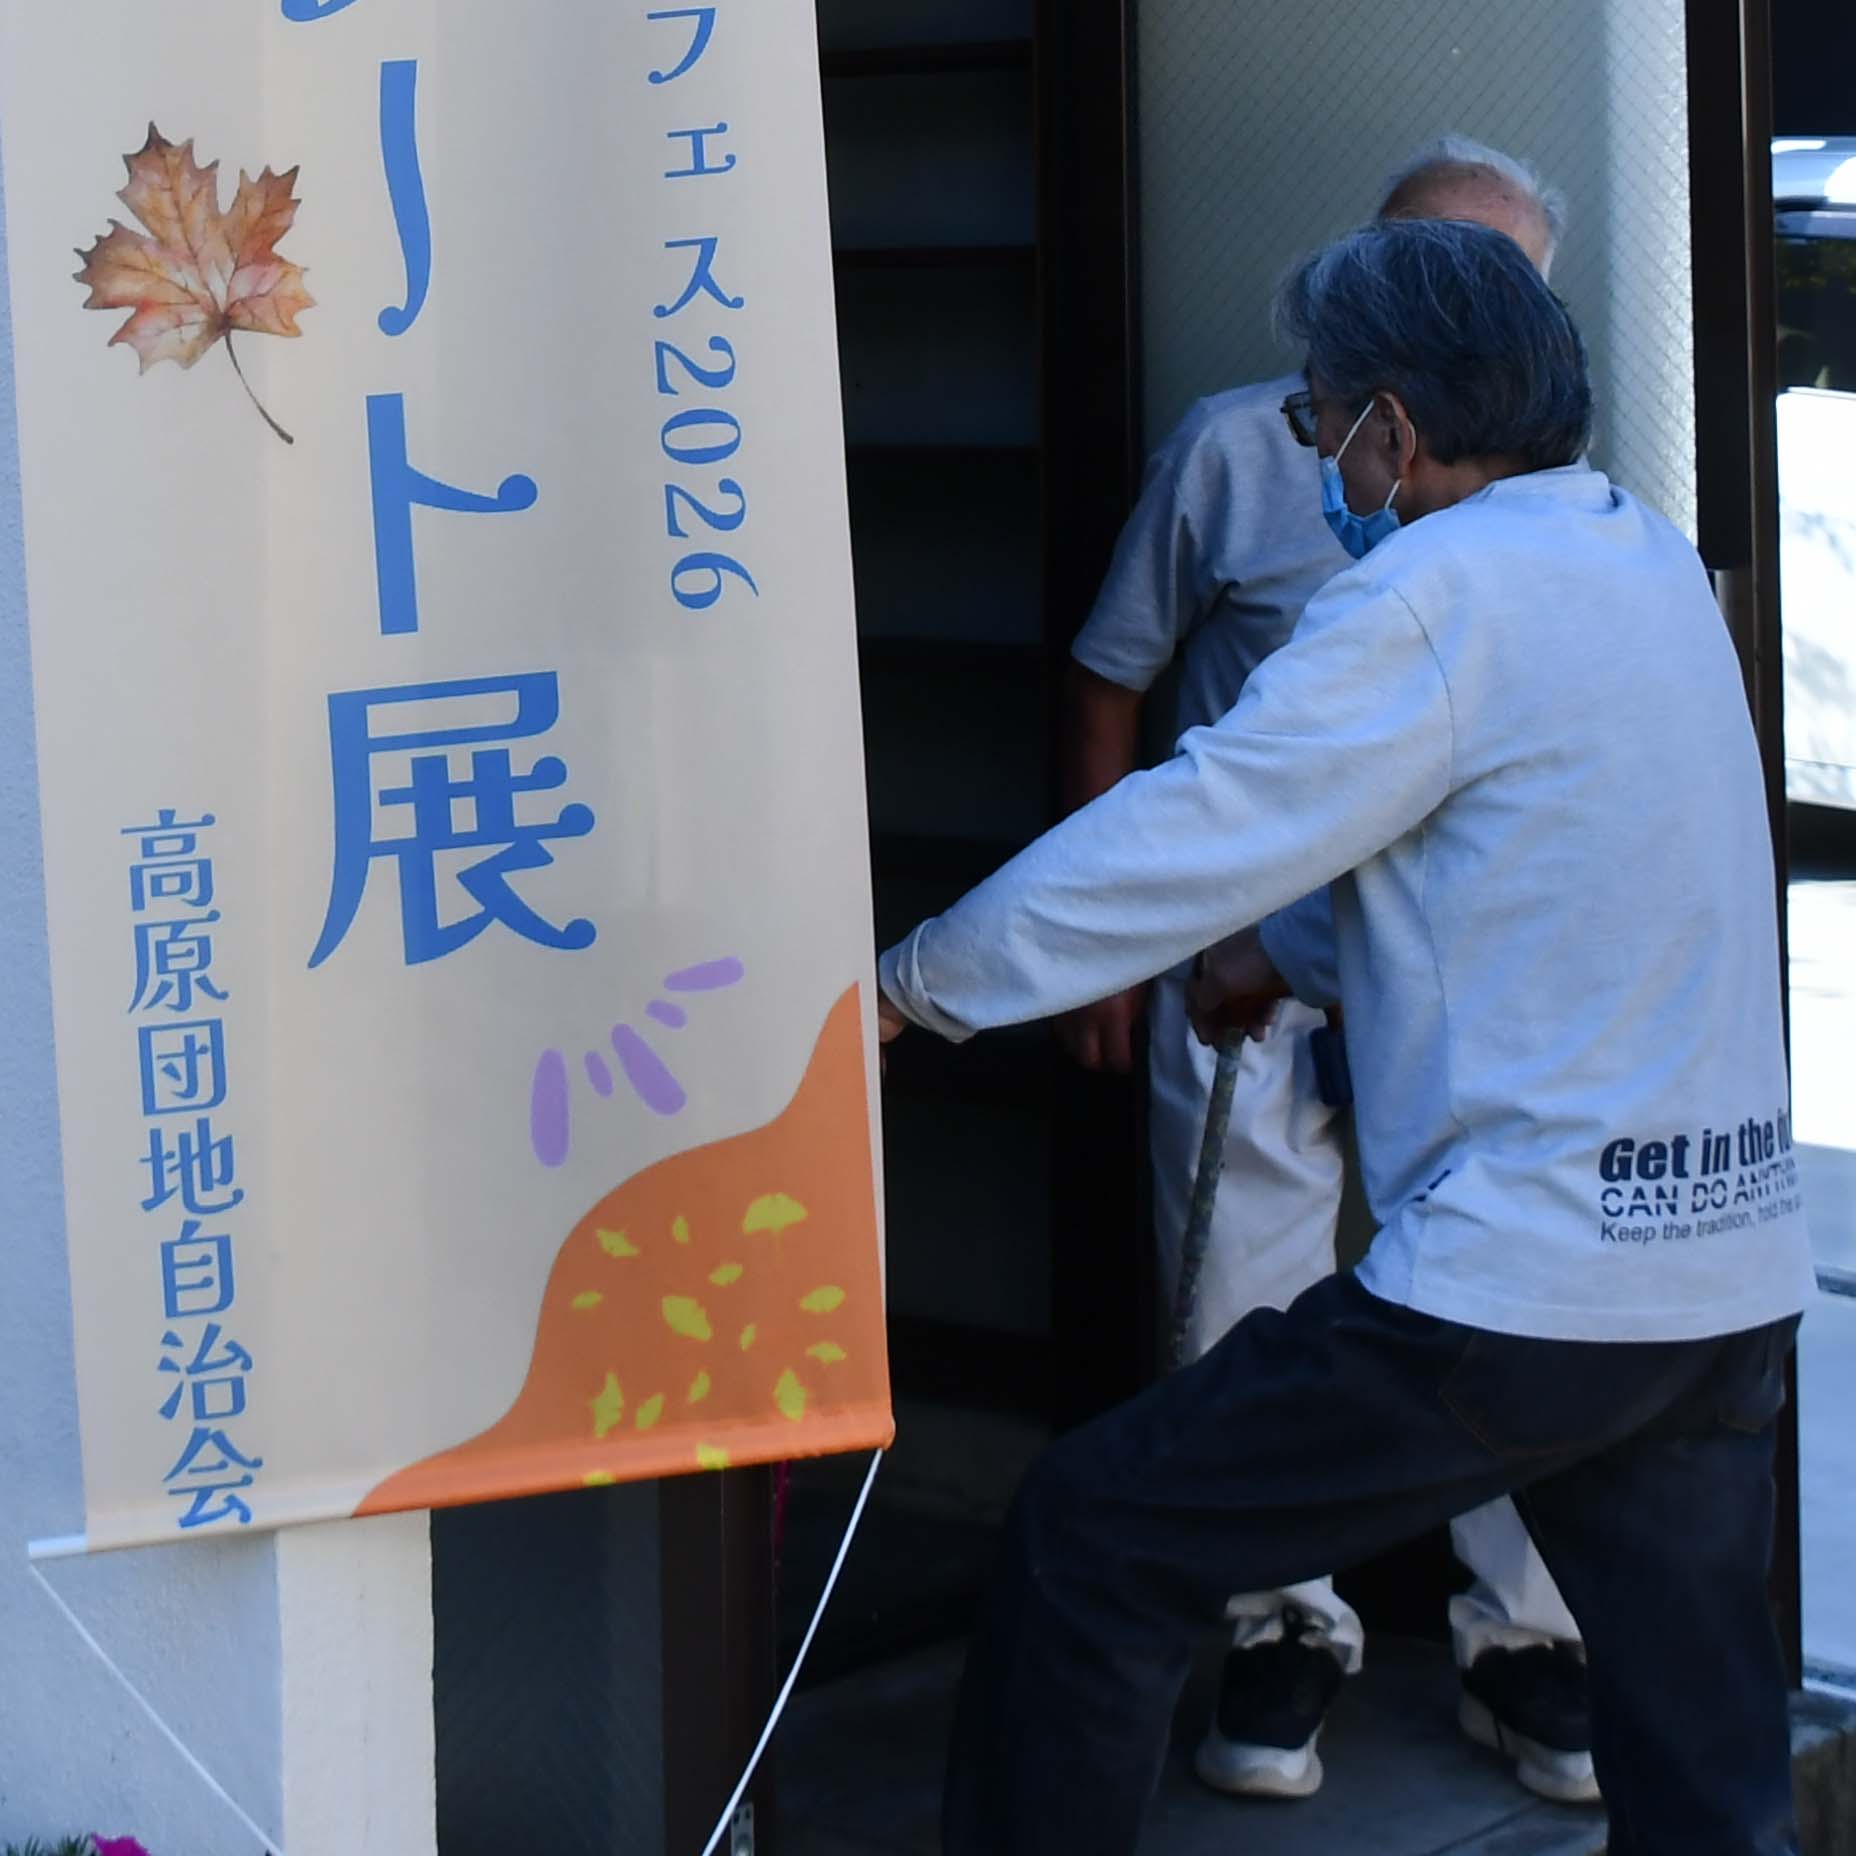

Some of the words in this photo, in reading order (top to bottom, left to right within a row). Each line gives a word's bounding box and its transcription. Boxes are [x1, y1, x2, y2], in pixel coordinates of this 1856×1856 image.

[120, 808, 263, 1529] 高原団地自治会
[1599, 1134, 1691, 1183] Get
[1700, 1127, 1731, 1177] in
[1738, 1117, 1774, 1167] the
[1601, 1185, 1679, 1218] CAN
[1691, 1178, 1728, 1214] DO
[1600, 1221, 1657, 1245] Keep
[1662, 1221, 1692, 1241] the
